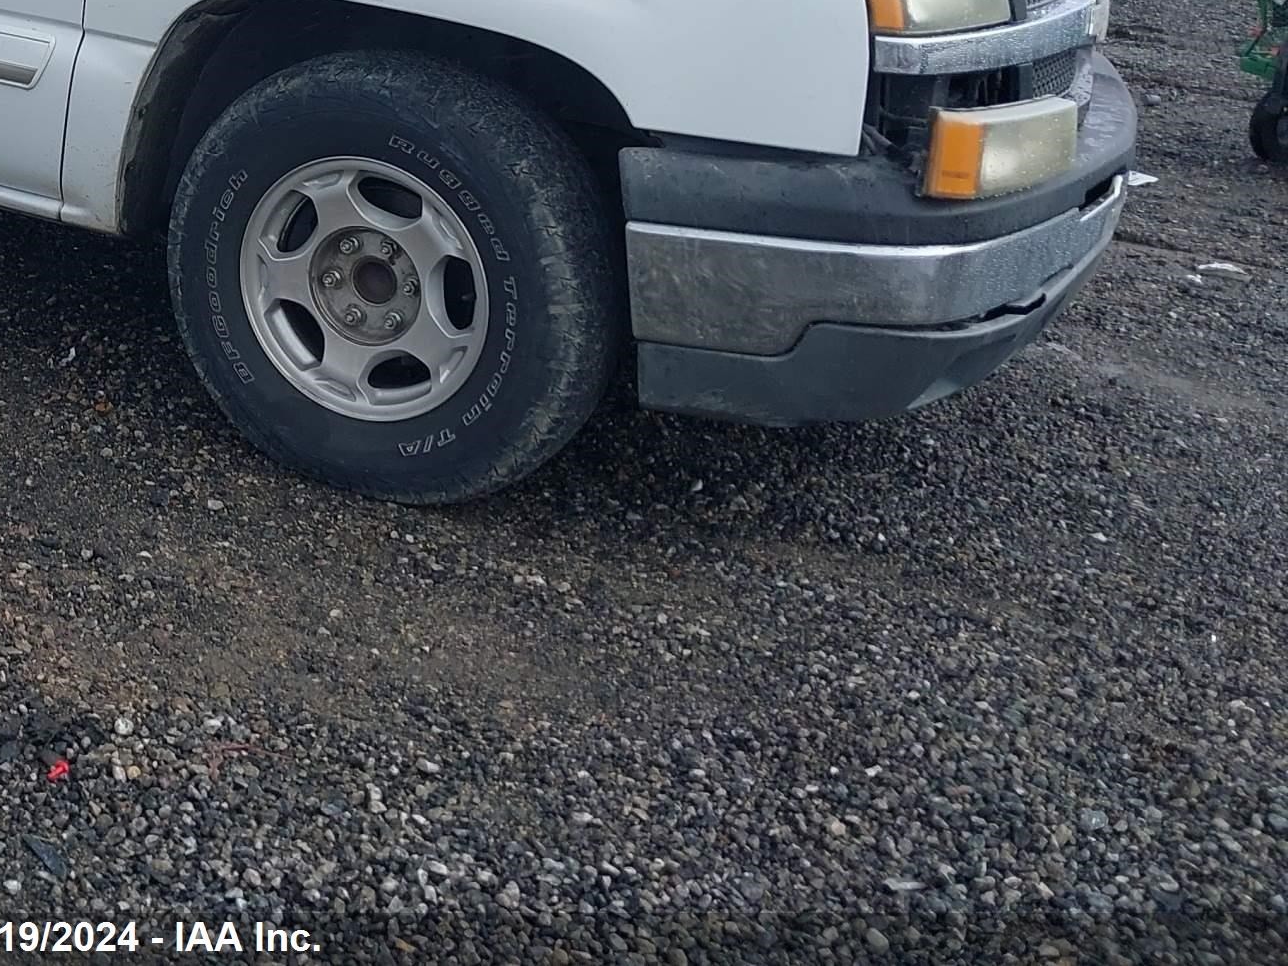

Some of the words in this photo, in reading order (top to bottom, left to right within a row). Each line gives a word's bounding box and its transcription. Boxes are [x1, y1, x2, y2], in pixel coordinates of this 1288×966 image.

[388, 134, 511, 261] Rugged
[205, 168, 256, 385] BFGoodrich
[462, 276, 519, 426] Terrain
[398, 428, 457, 457] T/A
